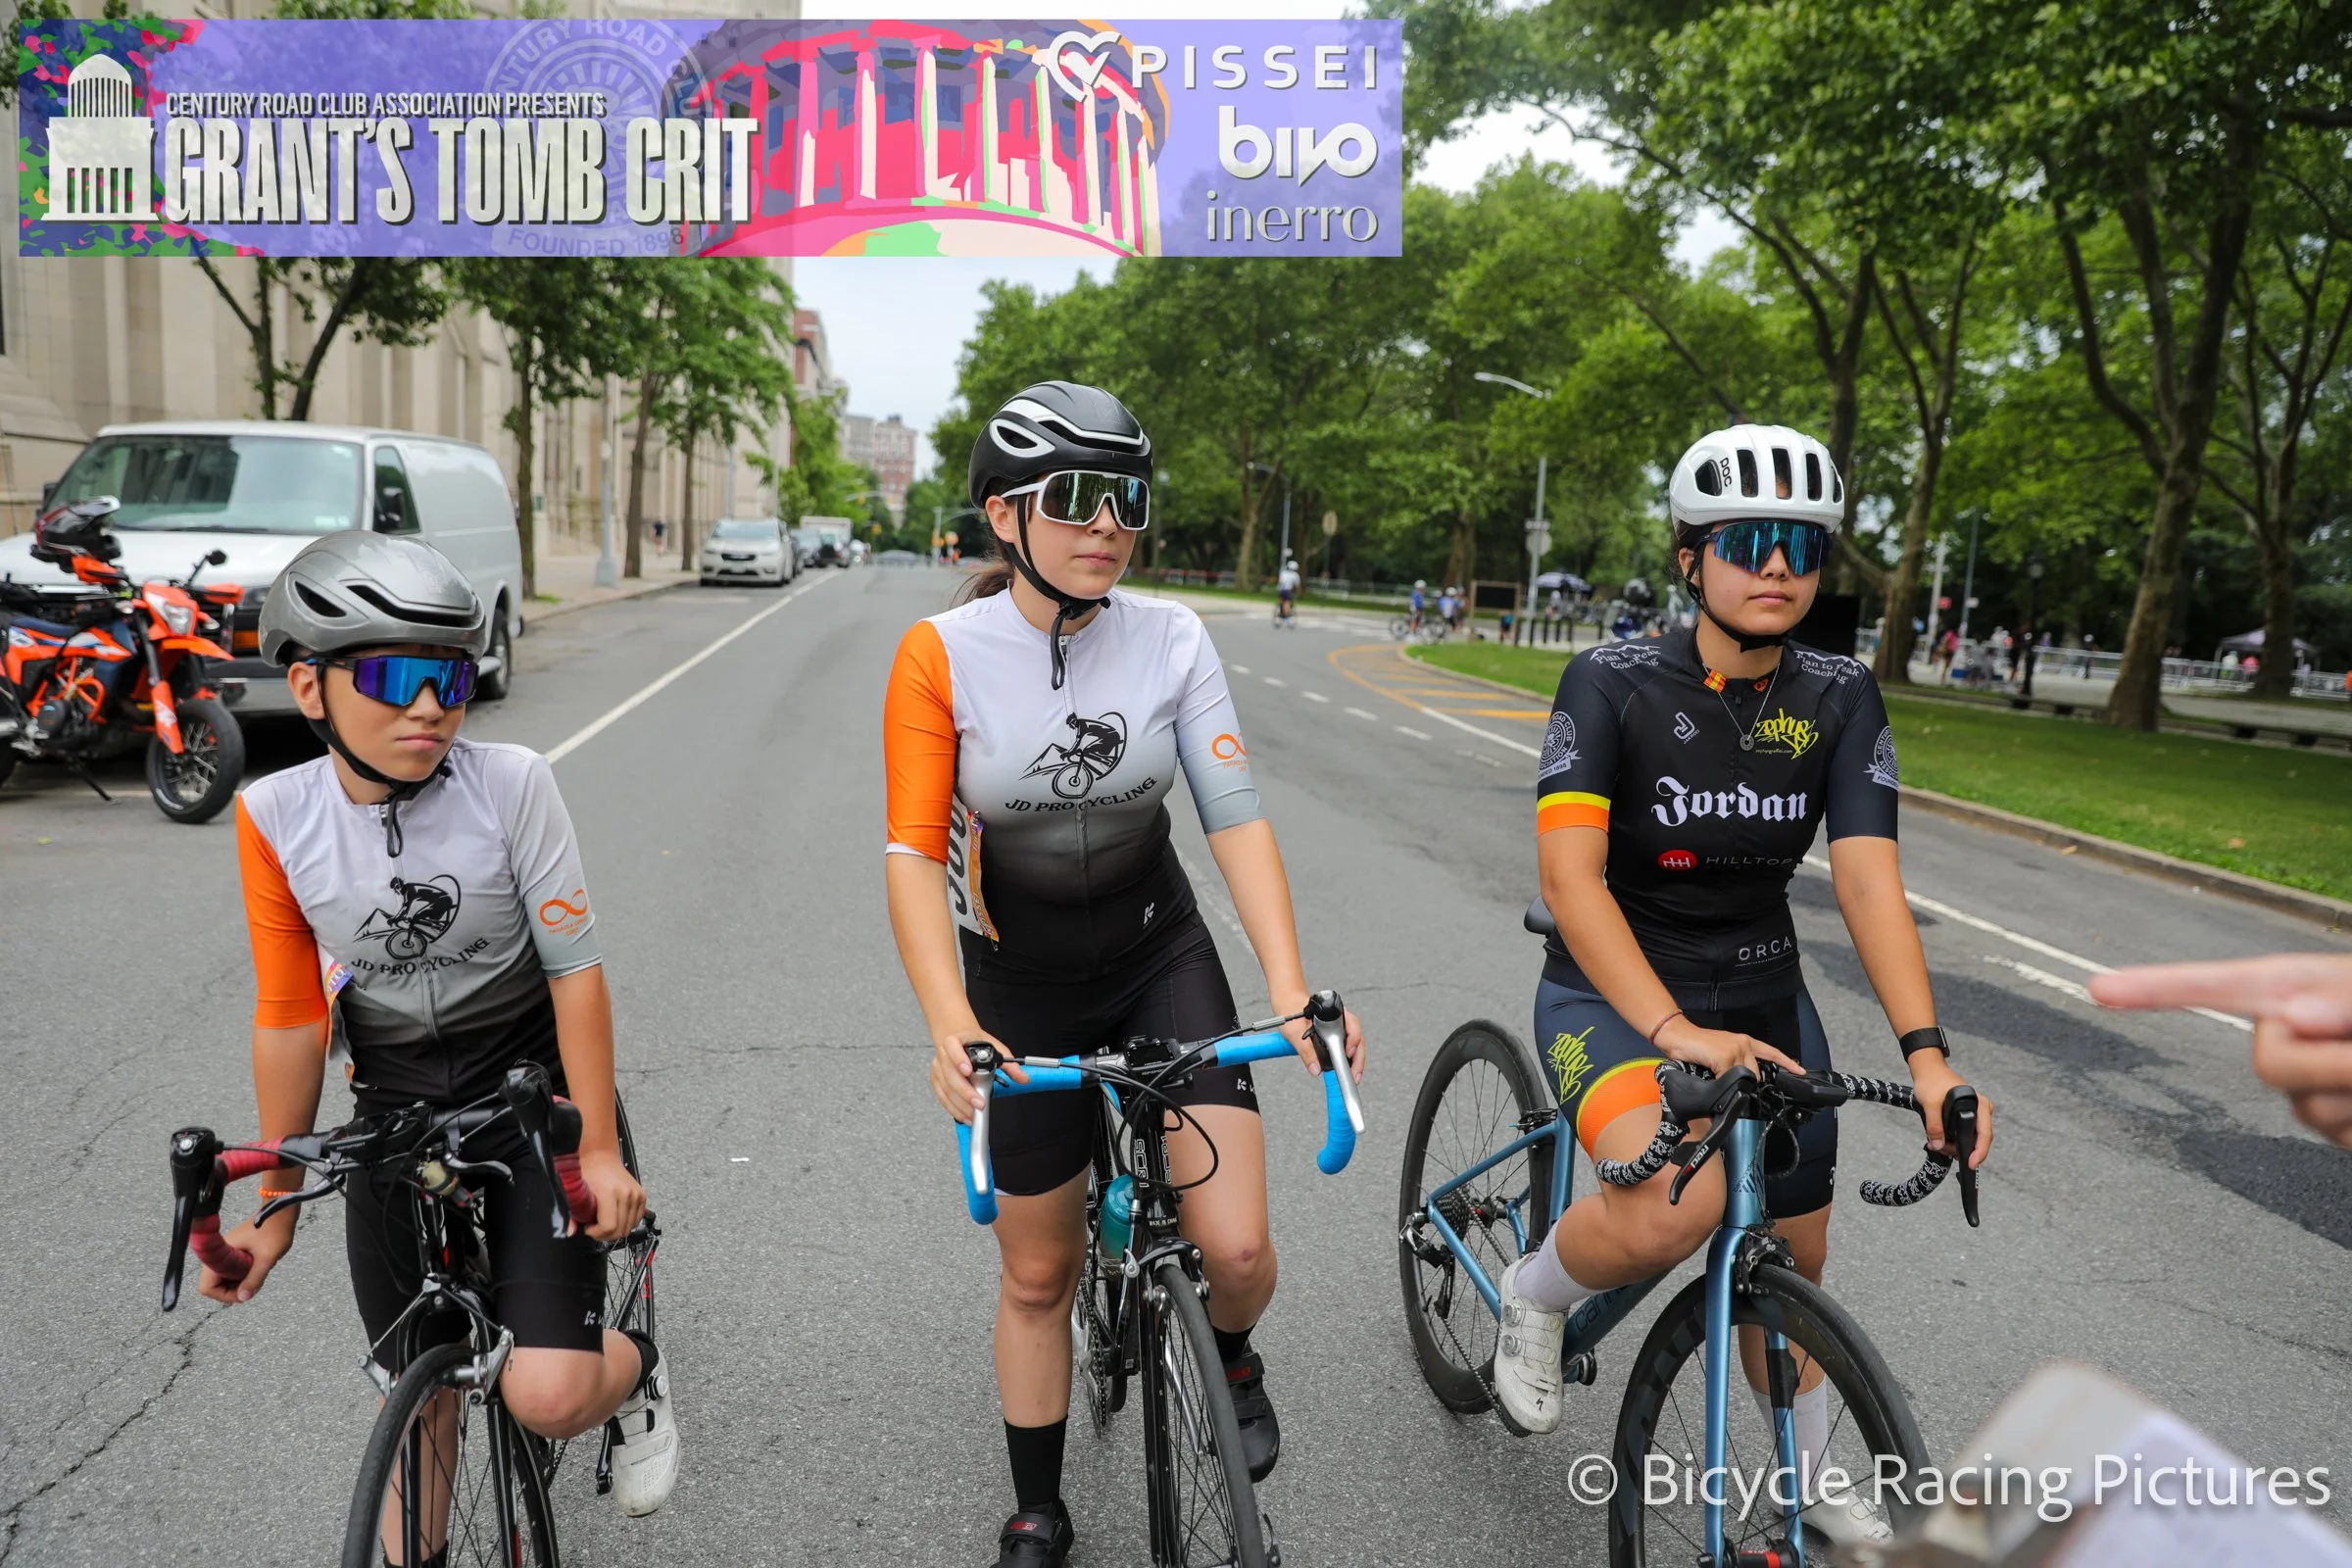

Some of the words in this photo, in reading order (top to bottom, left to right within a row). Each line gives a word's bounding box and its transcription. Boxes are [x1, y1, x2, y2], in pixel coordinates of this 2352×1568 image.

[1004, 799, 1032, 812] JD
[1034, 801, 1076, 812] PRO
[1077, 776, 1158, 812] CYCLING
[1650, 775, 1809, 827] Jordan
[351, 958, 374, 972] JD
[378, 960, 417, 976] PRO
[419, 937, 492, 973] CYCLING
[1738, 936, 1792, 961] ORCA
